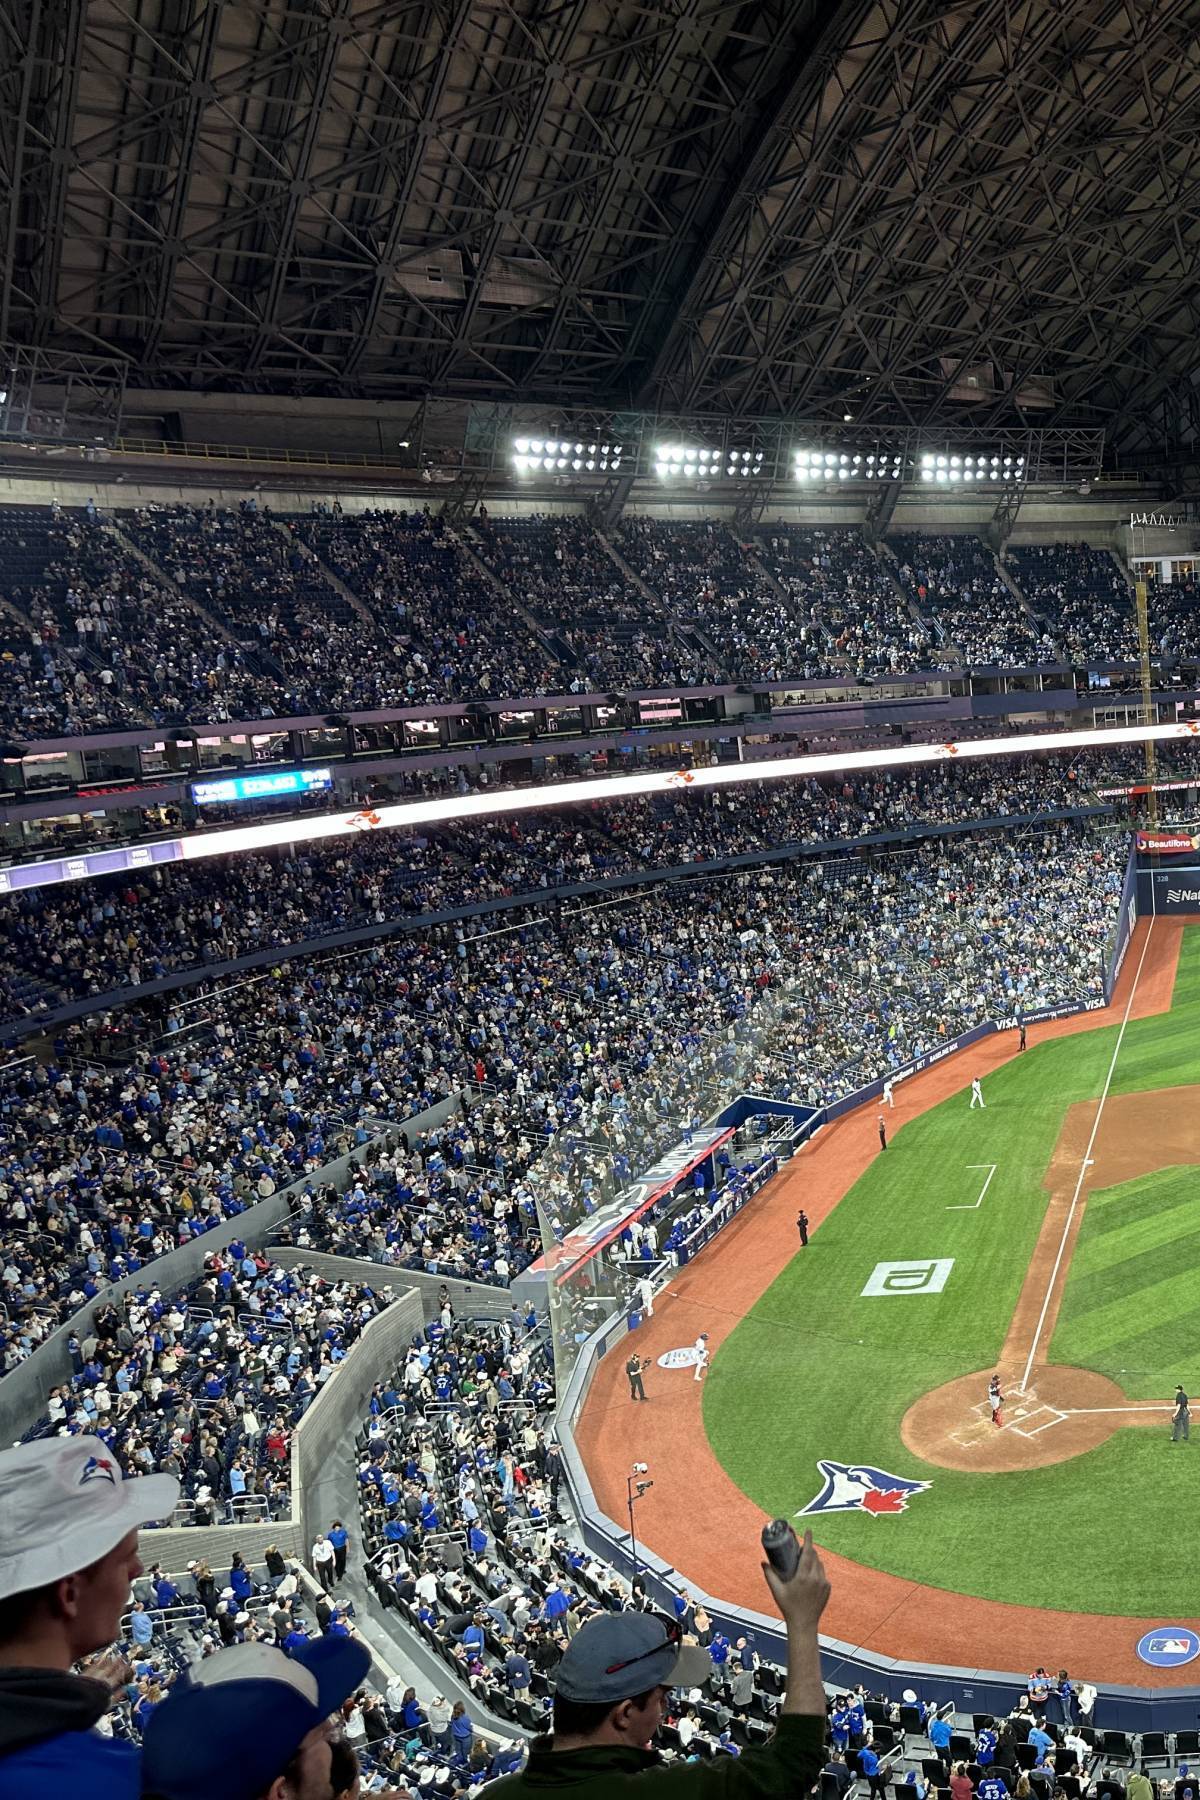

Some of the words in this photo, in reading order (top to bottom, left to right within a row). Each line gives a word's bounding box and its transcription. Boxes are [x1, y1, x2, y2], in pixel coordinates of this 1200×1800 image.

[1103, 788, 1125, 797] ROGERS
[1152, 784, 1169, 792] Proud
[1170, 782, 1188, 790] owner
[1156, 875, 1169, 883] 328
[1083, 997, 1106, 1011] VISA
[1022, 1011, 1049, 1022] everywhere
[994, 1016, 1019, 1031] VISA
[949, 1042, 959, 1052] BOX
[916, 1059, 926, 1070] BET
[883, 1262, 938, 1291] TD
[984, 1789, 1000, 1800] 43
